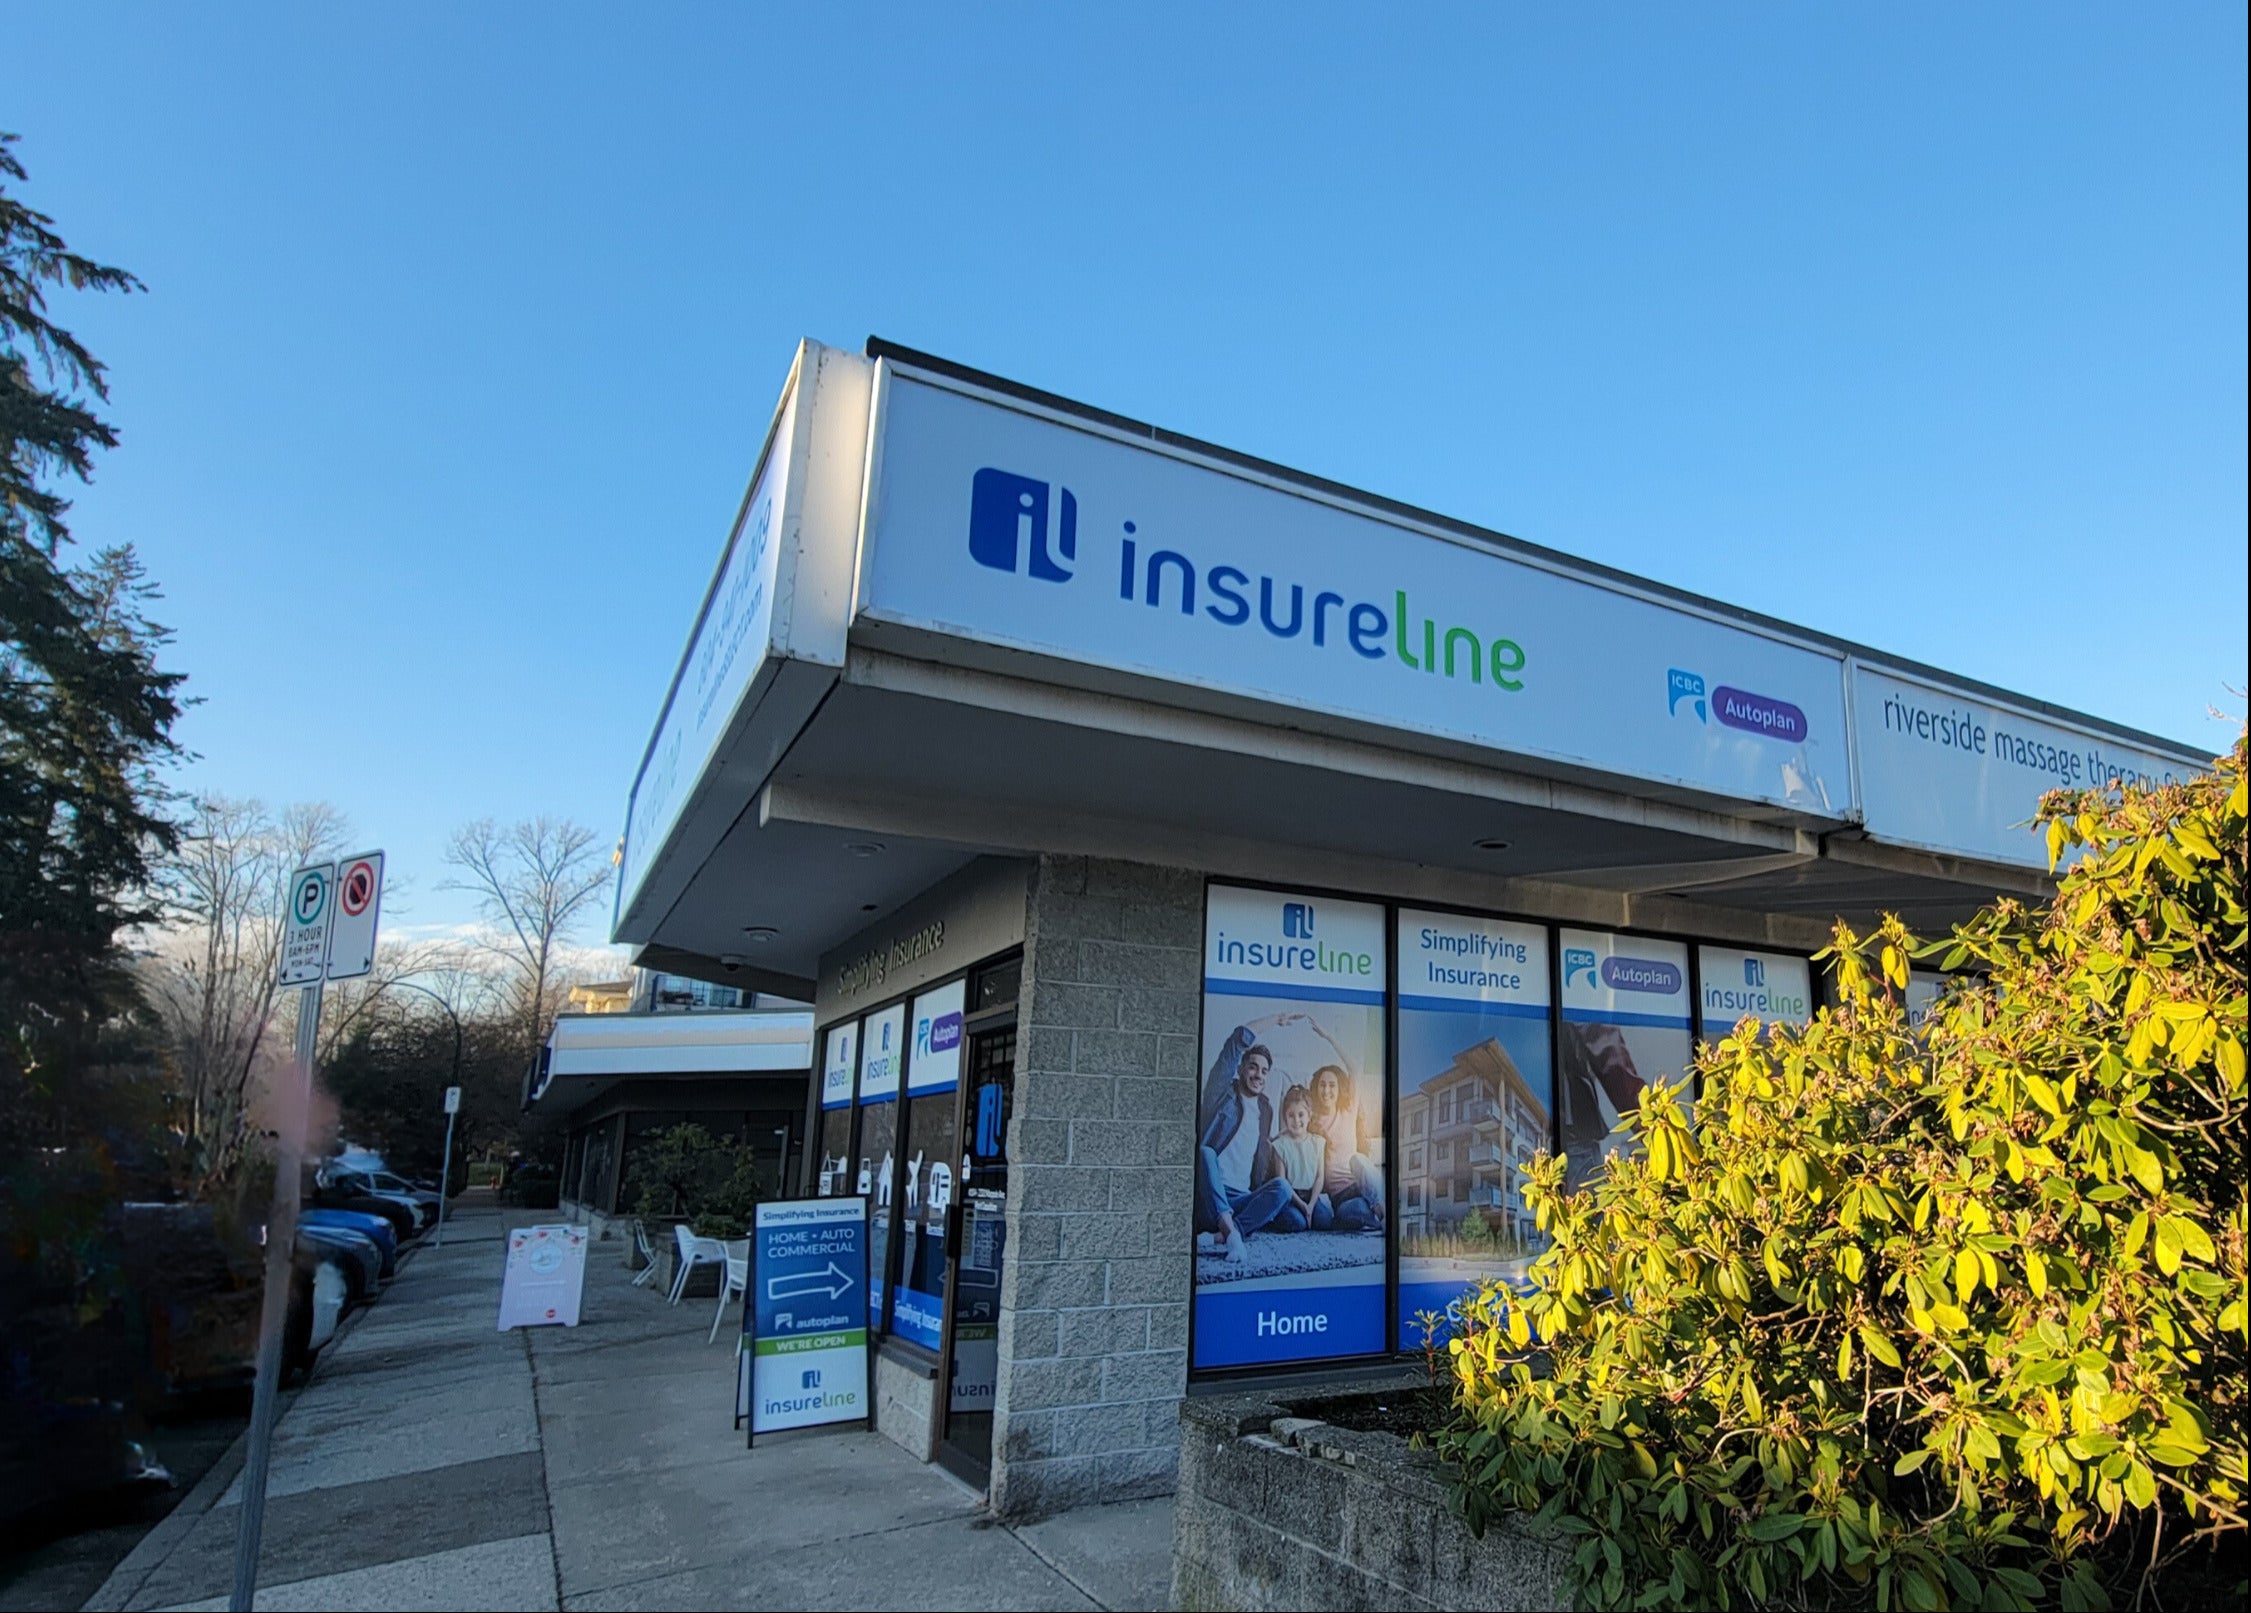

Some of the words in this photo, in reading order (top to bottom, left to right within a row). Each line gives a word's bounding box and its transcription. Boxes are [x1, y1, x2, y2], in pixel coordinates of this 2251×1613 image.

[1120, 520, 1526, 692] insureline
[1672, 674, 1701, 693] ICBC
[1725, 698, 1795, 731] Autoplan
[1884, 693, 1986, 755] riverside
[1995, 729, 2081, 786] massage
[297, 925, 323, 944] HOUR
[890, 920, 944, 972] Insurance
[1420, 928, 1527, 964] Simplifying
[1218, 932, 1372, 975] insureline
[1568, 953, 1593, 966] ICBC
[1428, 961, 1521, 989] Insurance
[1612, 966, 1672, 988] Autoplan
[1705, 982, 1803, 1015] insureline
[763, 1210, 815, 1221] Simplifying
[816, 1207, 859, 1217] Insurance
[768, 1231, 808, 1245] HOME
[820, 1228, 855, 1241] AUTO
[767, 1242, 856, 1258] COMMERCIAL
[796, 1314, 849, 1328] autoplan
[1257, 1311, 1328, 1337] Home
[813, 1335, 846, 1348] OPEN
[765, 1391, 856, 1415] insureline
